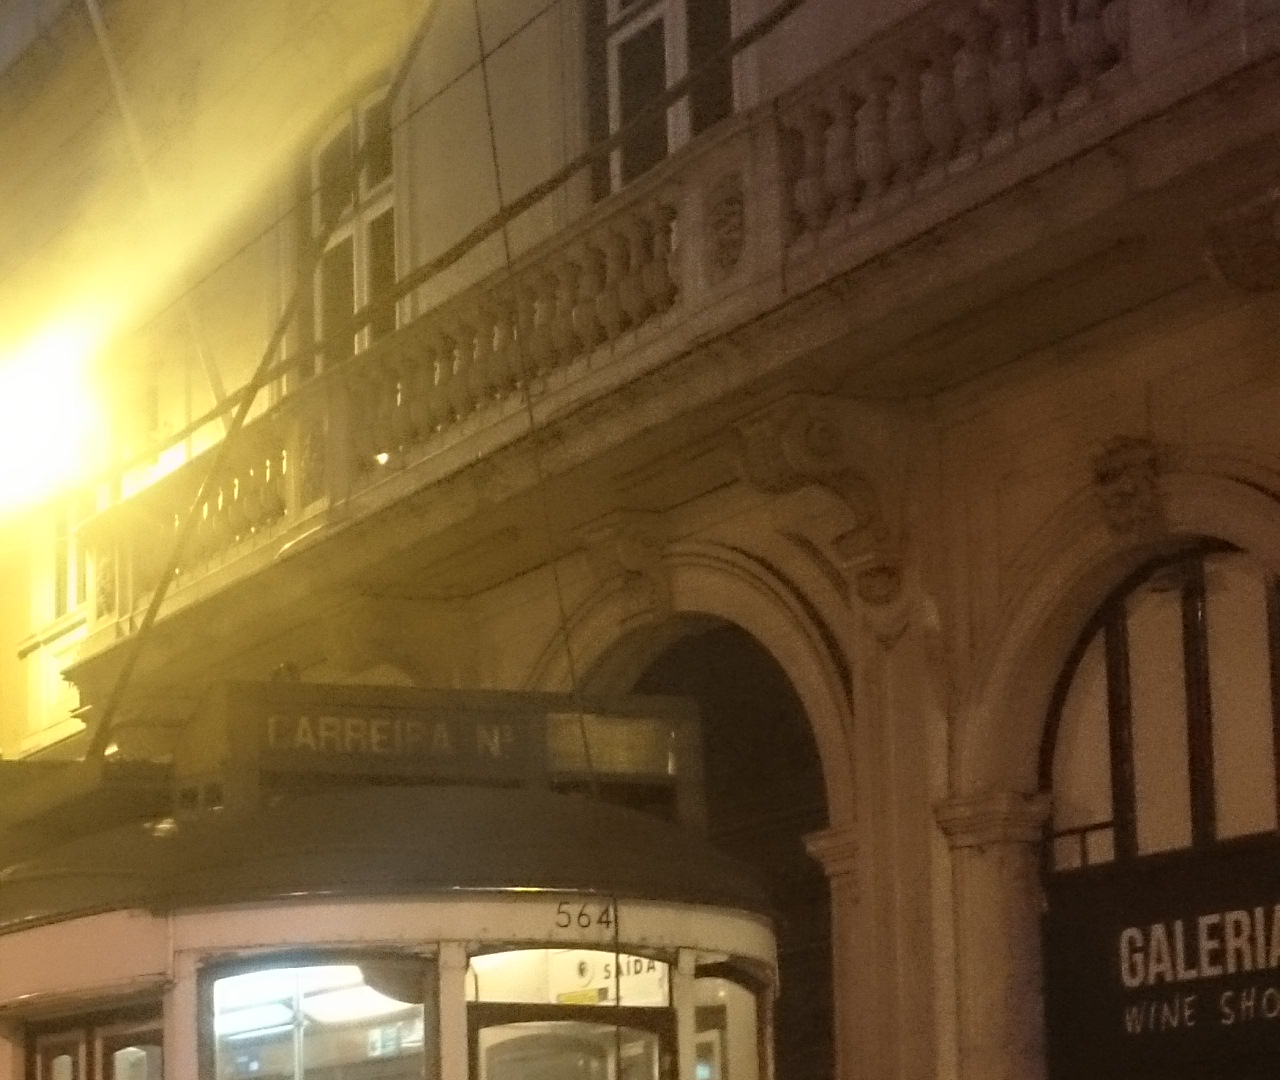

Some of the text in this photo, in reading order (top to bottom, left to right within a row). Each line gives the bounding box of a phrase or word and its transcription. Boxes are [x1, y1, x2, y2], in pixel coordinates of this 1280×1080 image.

[266, 713, 453, 757] CARREIRA
[555, 901, 613, 929] 564
[1124, 993, 1198, 1034] WINE
